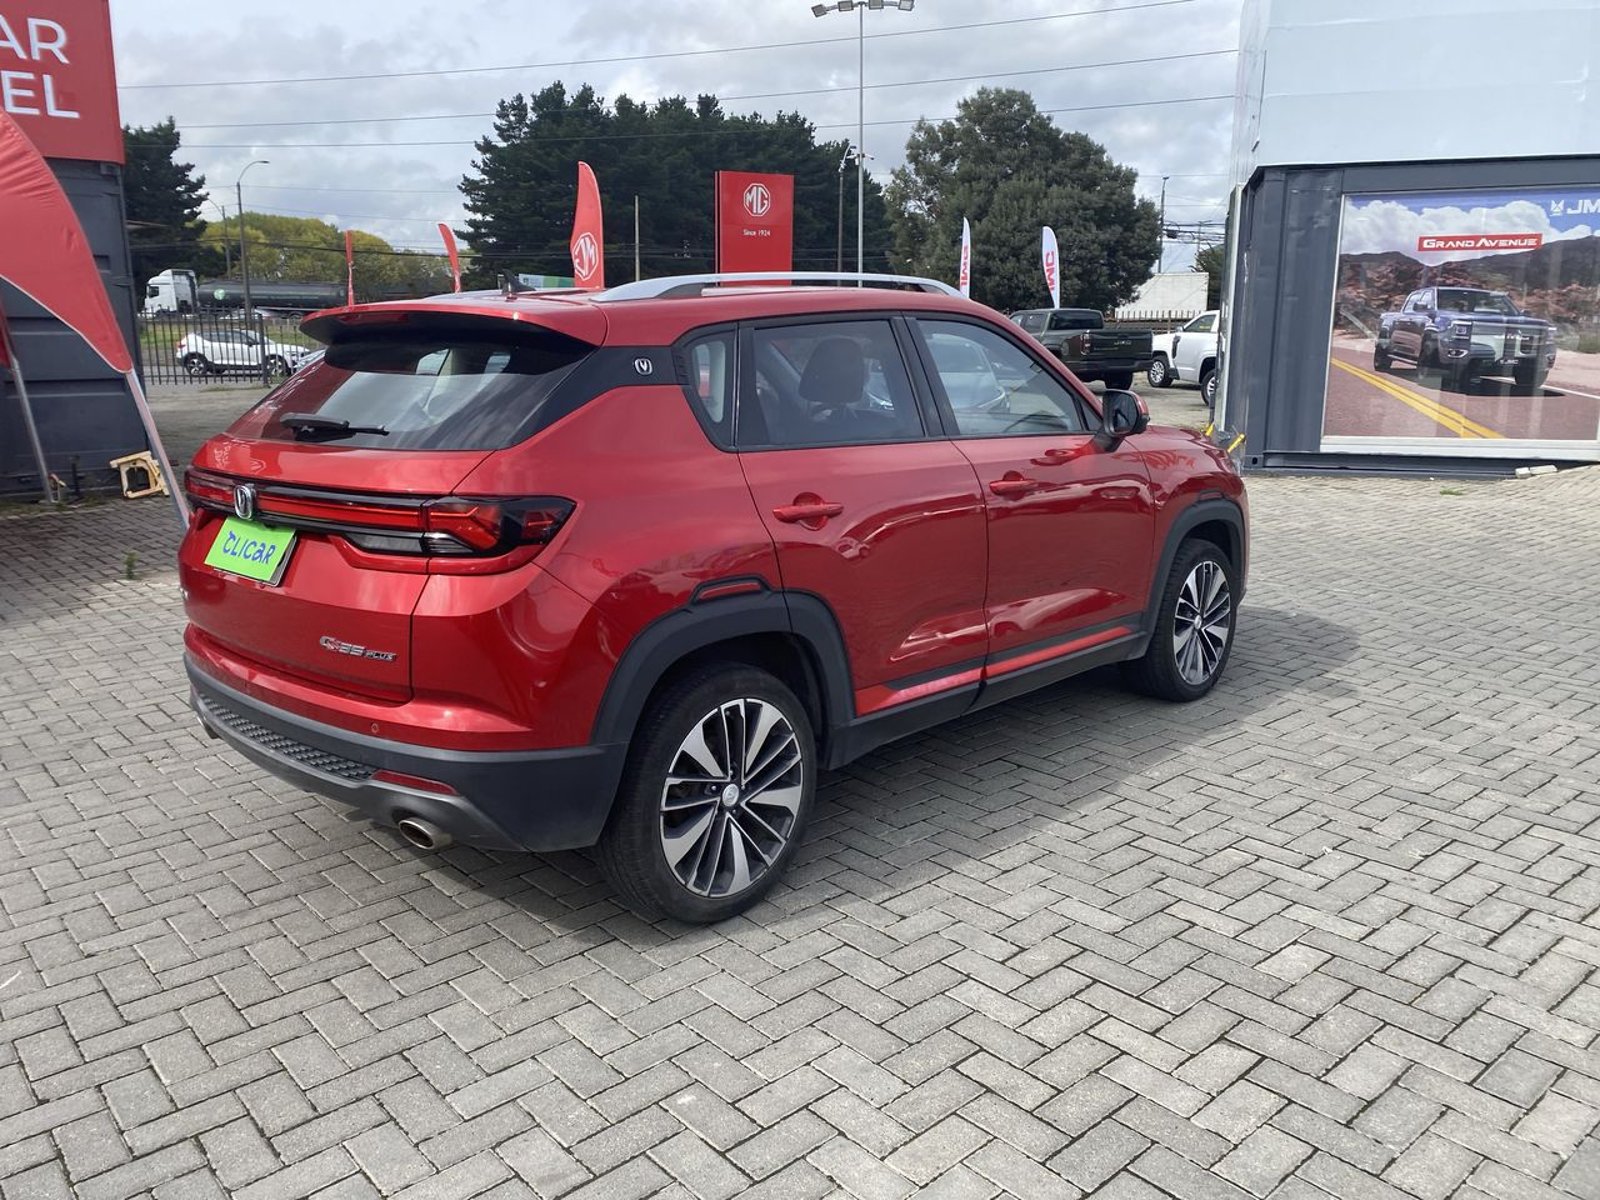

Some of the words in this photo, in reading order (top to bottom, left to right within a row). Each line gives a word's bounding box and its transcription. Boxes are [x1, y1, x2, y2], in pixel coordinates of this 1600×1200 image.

[0, 70, 80, 118] EL
[745, 185, 769, 214] MG
[1423, 238, 1475, 248] GRAND
[1475, 237, 1538, 247] AVENUE
